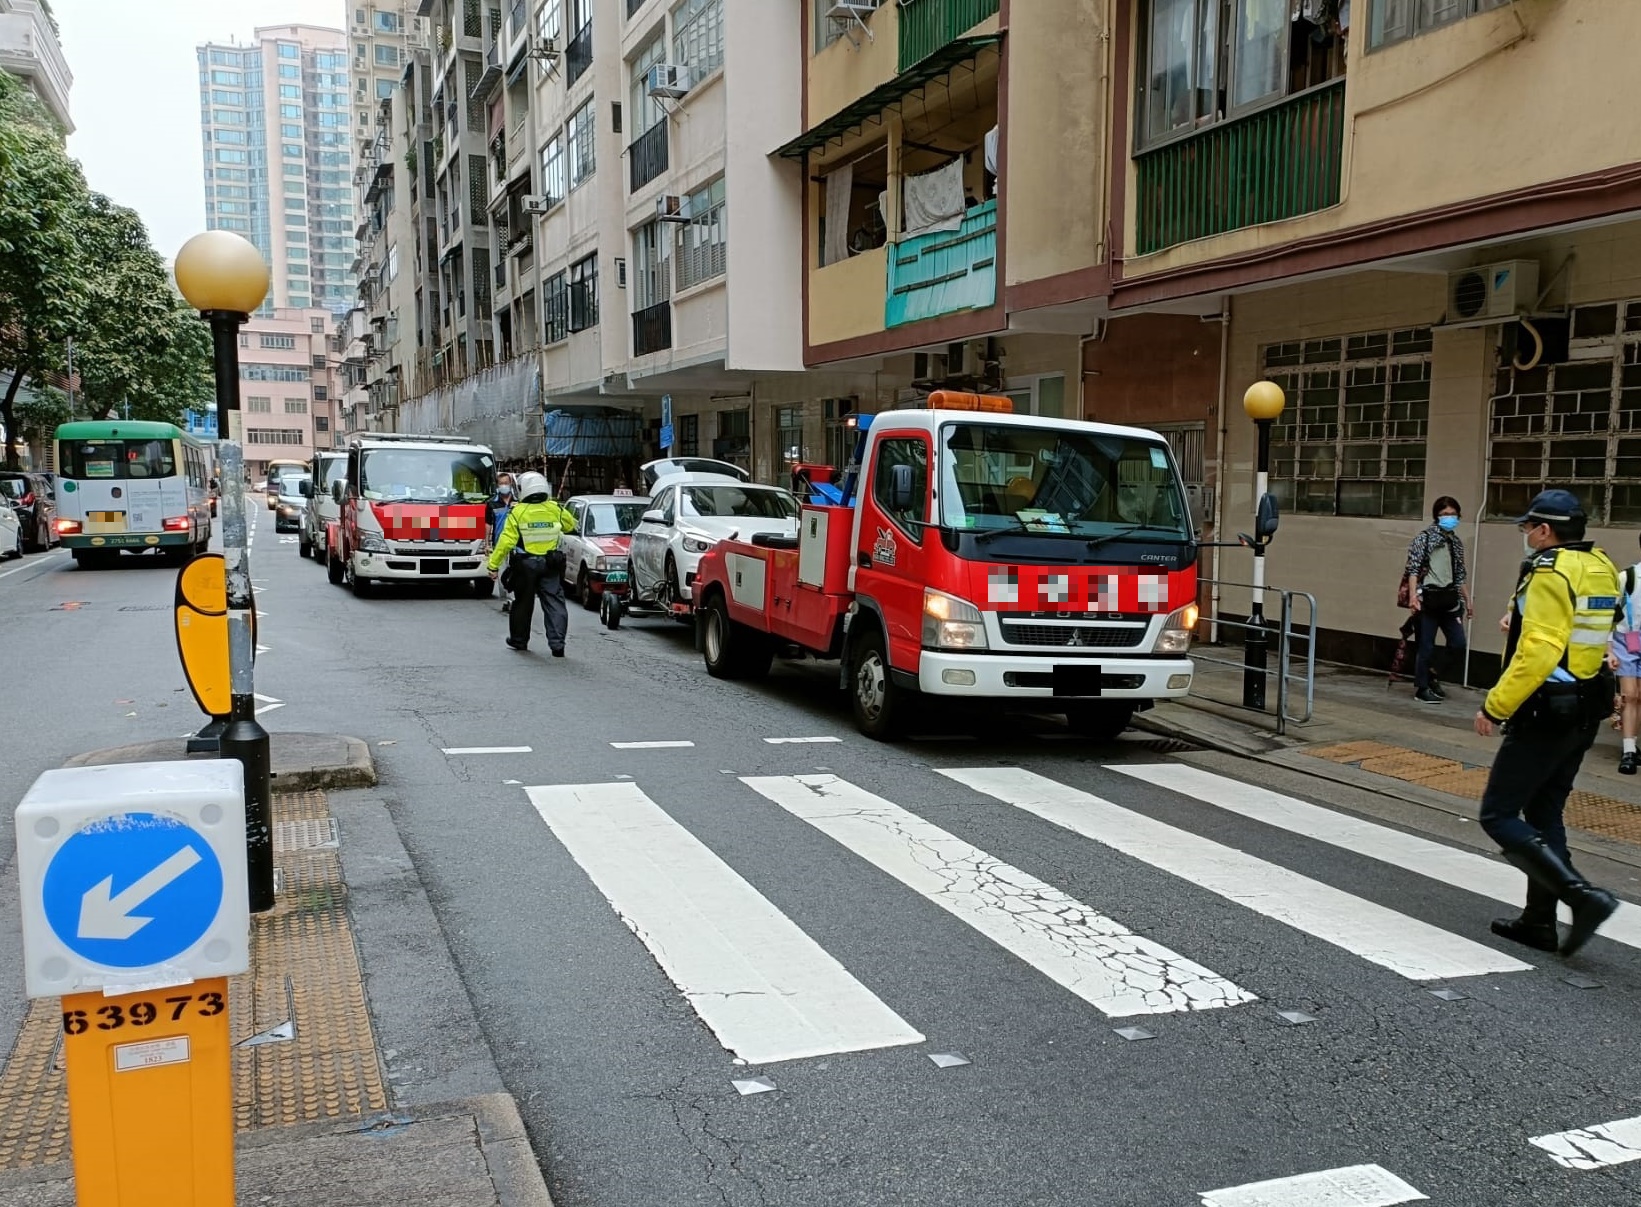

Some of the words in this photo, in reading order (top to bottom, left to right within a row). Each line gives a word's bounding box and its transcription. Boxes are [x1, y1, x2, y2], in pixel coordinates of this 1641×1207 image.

[1140, 554, 1177, 562] CANTER
[63, 992, 225, 1036] 63973
[144, 1056, 163, 1064] 1823
